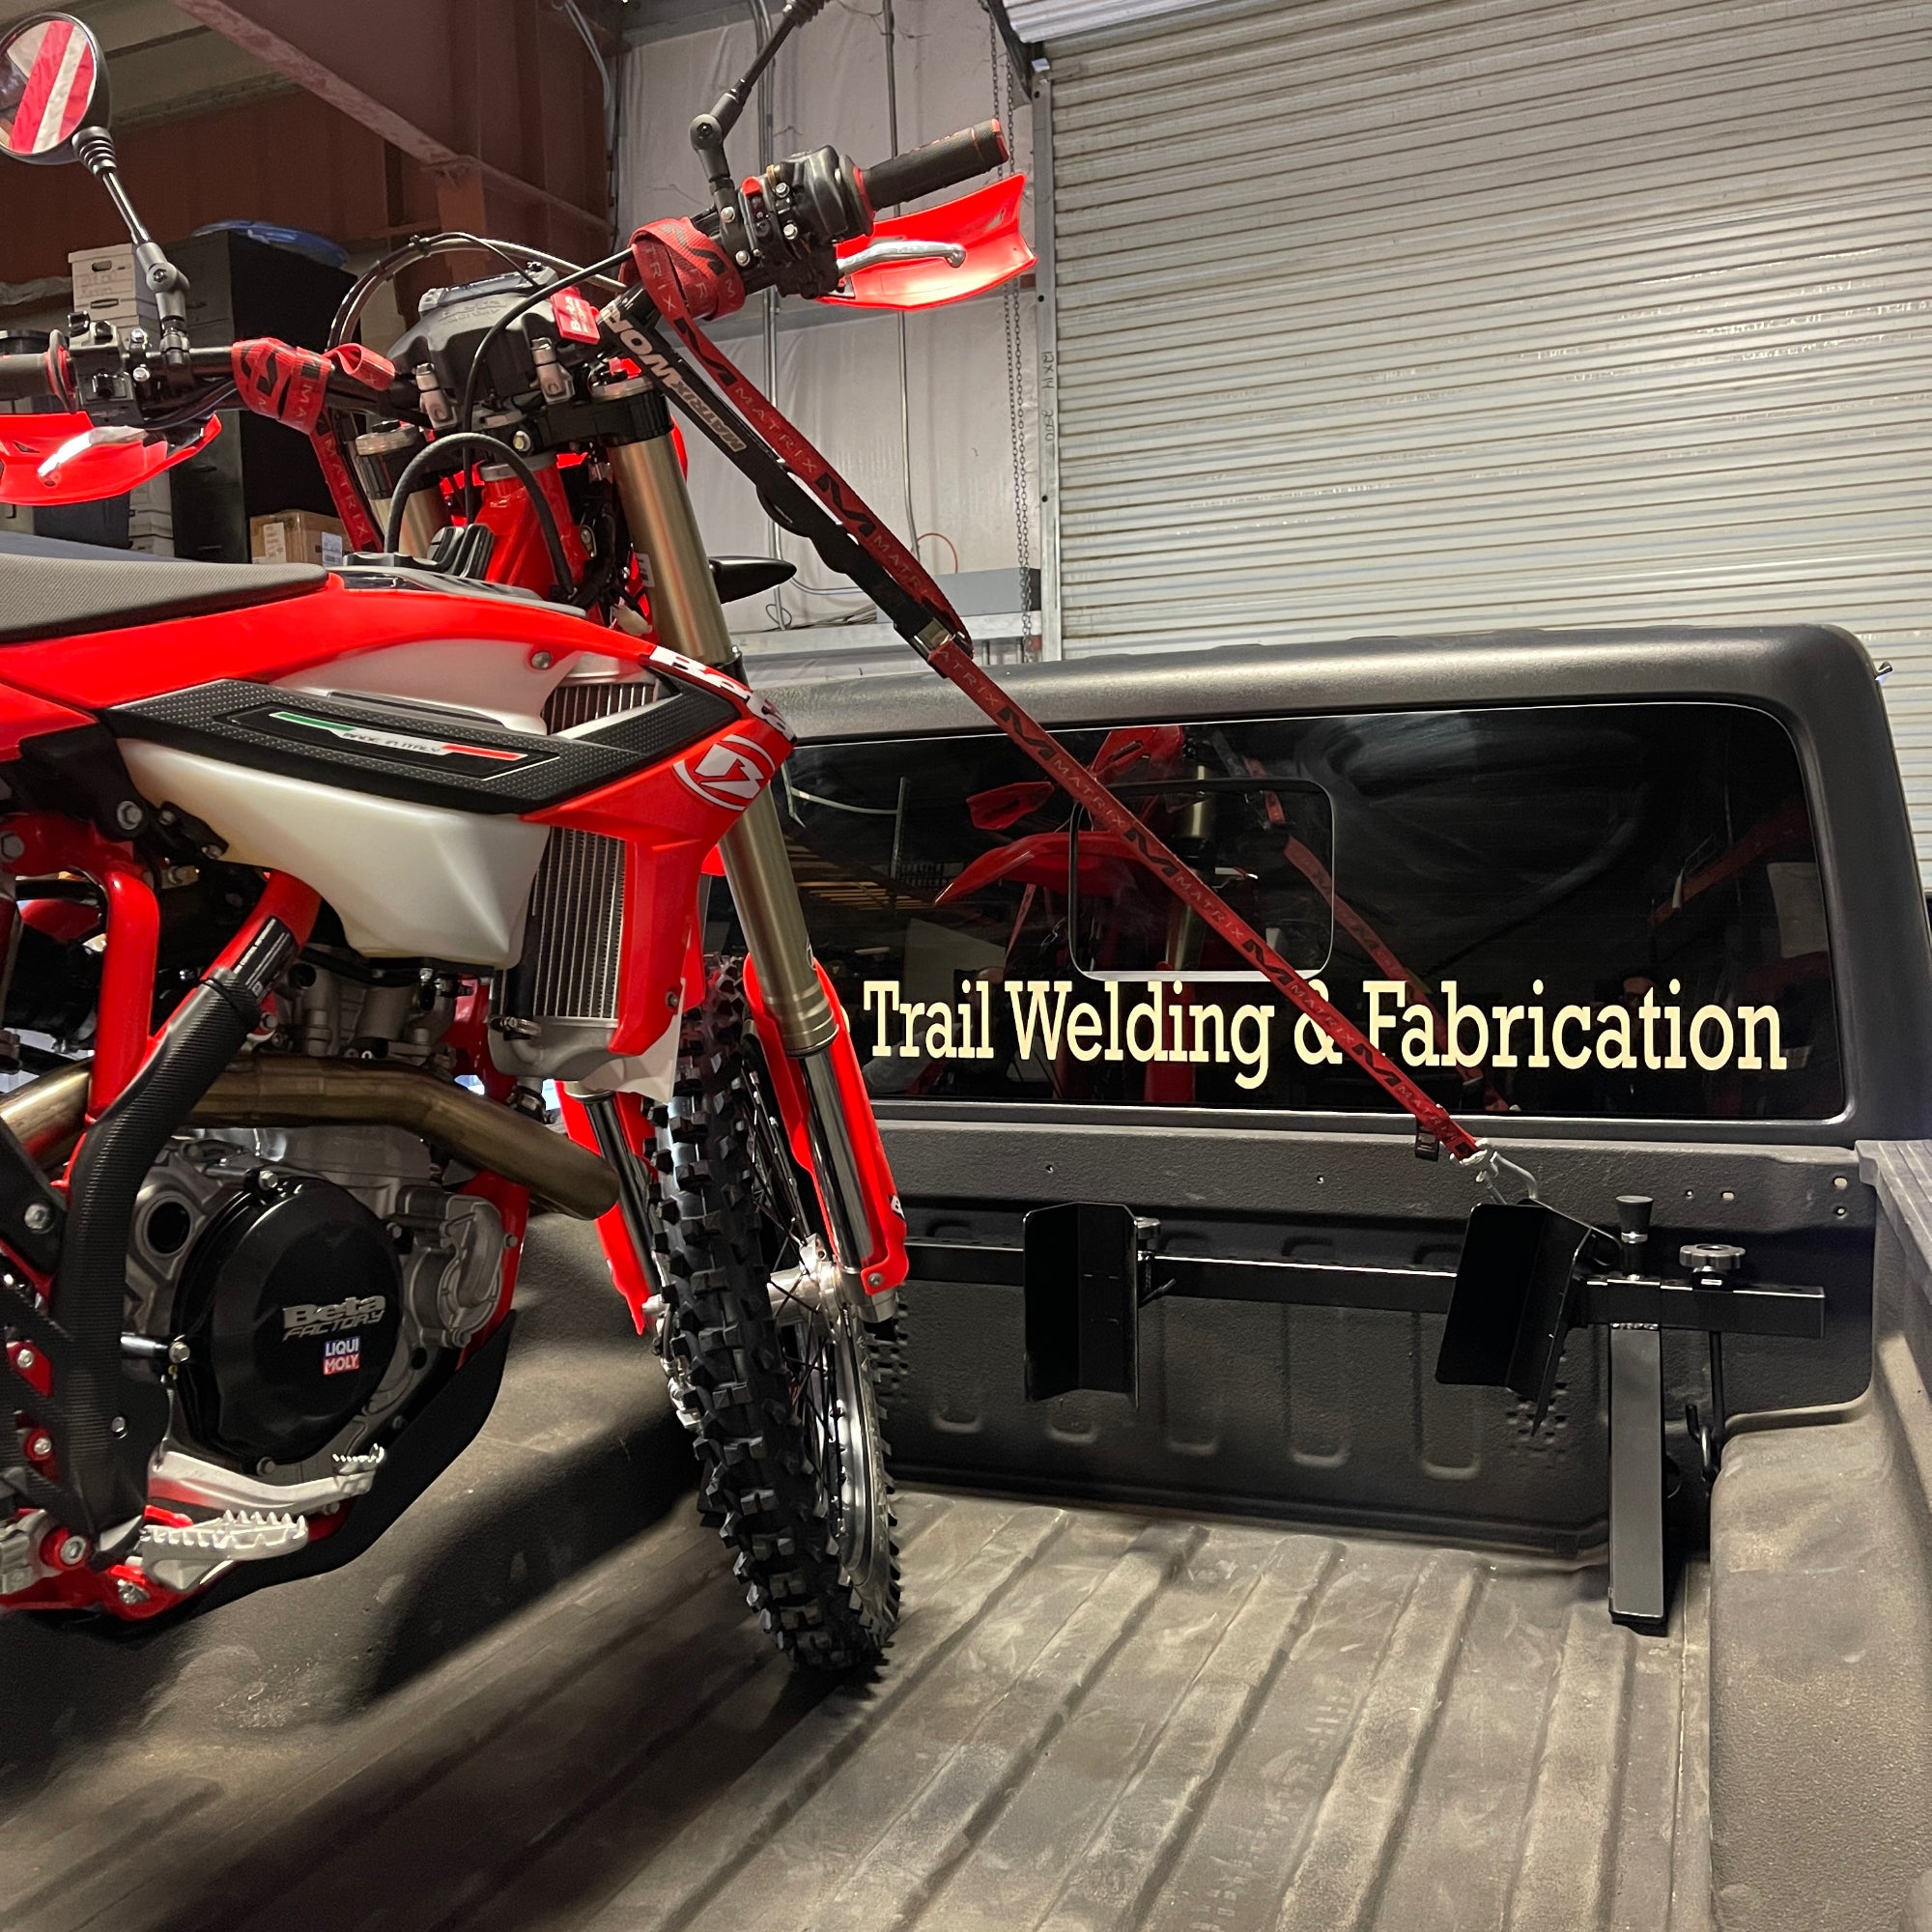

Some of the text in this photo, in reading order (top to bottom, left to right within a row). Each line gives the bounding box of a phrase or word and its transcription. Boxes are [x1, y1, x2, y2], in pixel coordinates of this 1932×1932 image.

[735, 387, 817, 473] MATRIX
[649, 645, 797, 746] Beta
[1053, 759, 1126, 827] MATRIX
[1176, 876, 1244, 939] MATRIX
[864, 980, 994, 1059] Trail
[1005, 979, 1275, 1090] Welding
[1362, 979, 1787, 1070] Fabrication
[1290, 984, 1355, 1044] MATRIX
[281, 1309, 384, 1342] FACTORY
[282, 1295, 385, 1329] Beta
[324, 1353, 359, 1376] MOLY
[325, 1338, 359, 1357] LIQUI
